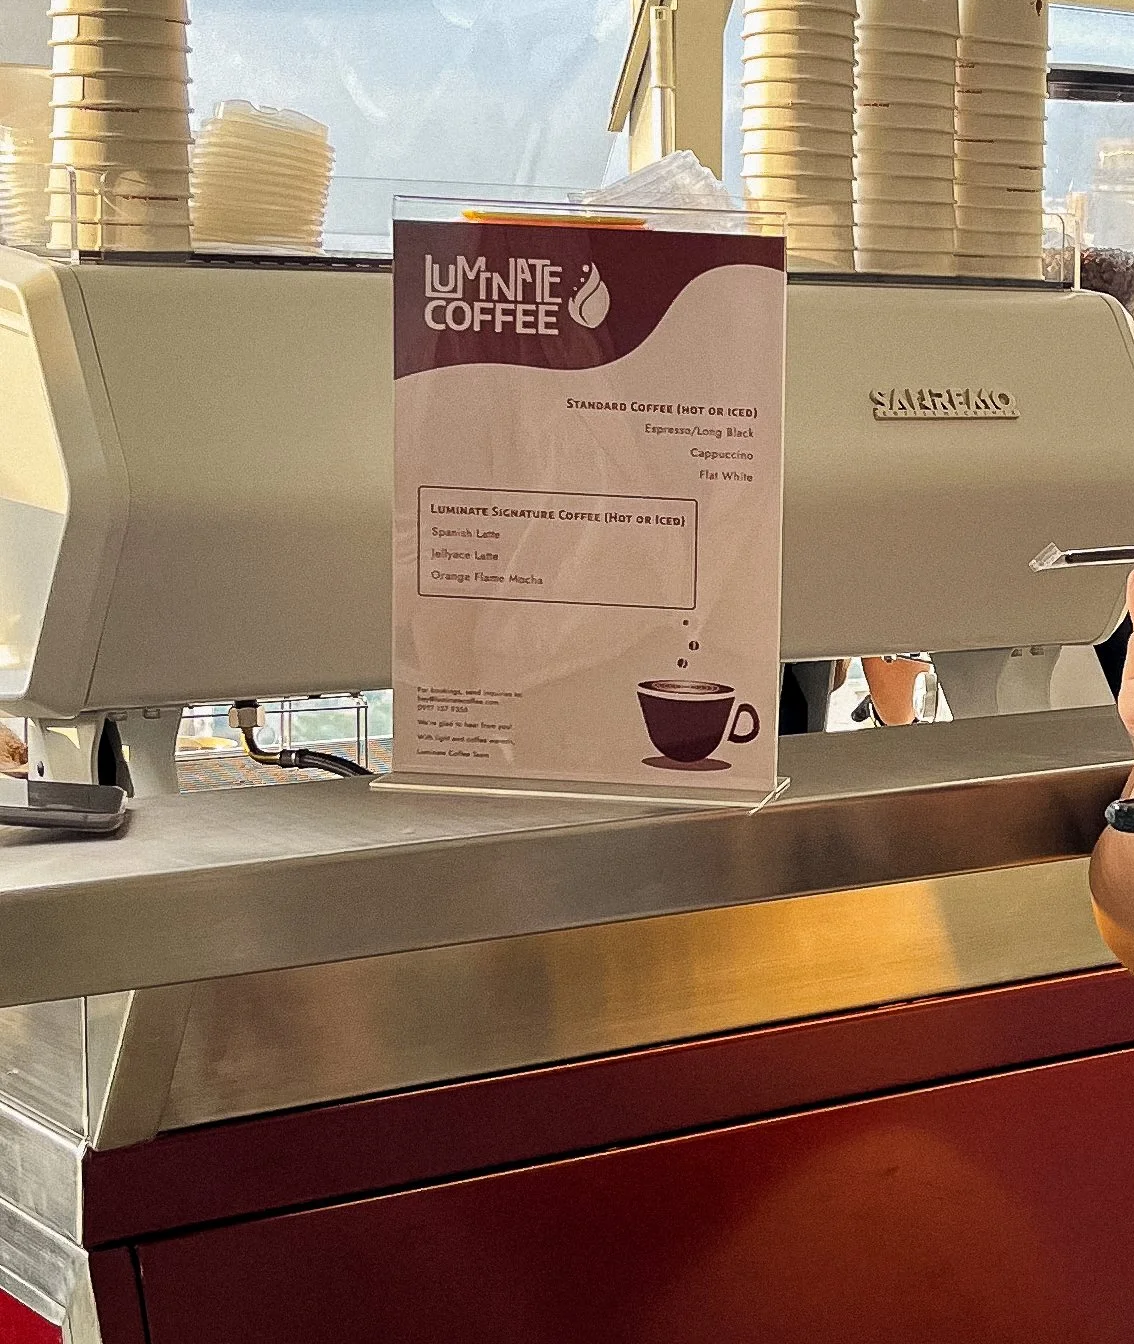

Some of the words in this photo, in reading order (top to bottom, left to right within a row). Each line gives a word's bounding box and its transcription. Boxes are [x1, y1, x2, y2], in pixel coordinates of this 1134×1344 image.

[425, 254, 562, 304] LUMINATE
[424, 299, 559, 336] COFFEE
[566, 398, 627, 412] STANDARD
[630, 401, 673, 415] COFFEE
[869, 388, 1016, 411] SANREMO
[644, 423, 722, 439] Espresso/Long
[726, 427, 754, 438] Black
[690, 447, 754, 461] Cappuccino
[699, 469, 719, 481] Flat
[722, 472, 753, 483] White
[430, 503, 489, 516] LUMINATE
[492, 506, 555, 520] SIGNATURE
[558, 510, 601, 523] COFFEE
[431, 527, 472, 538] Spanish
[476, 529, 500, 539] Latte
[475, 551, 499, 561] Latte
[431, 570, 470, 583] Orange
[474, 572, 504, 582] Flame
[509, 574, 543, 585] Mocha
